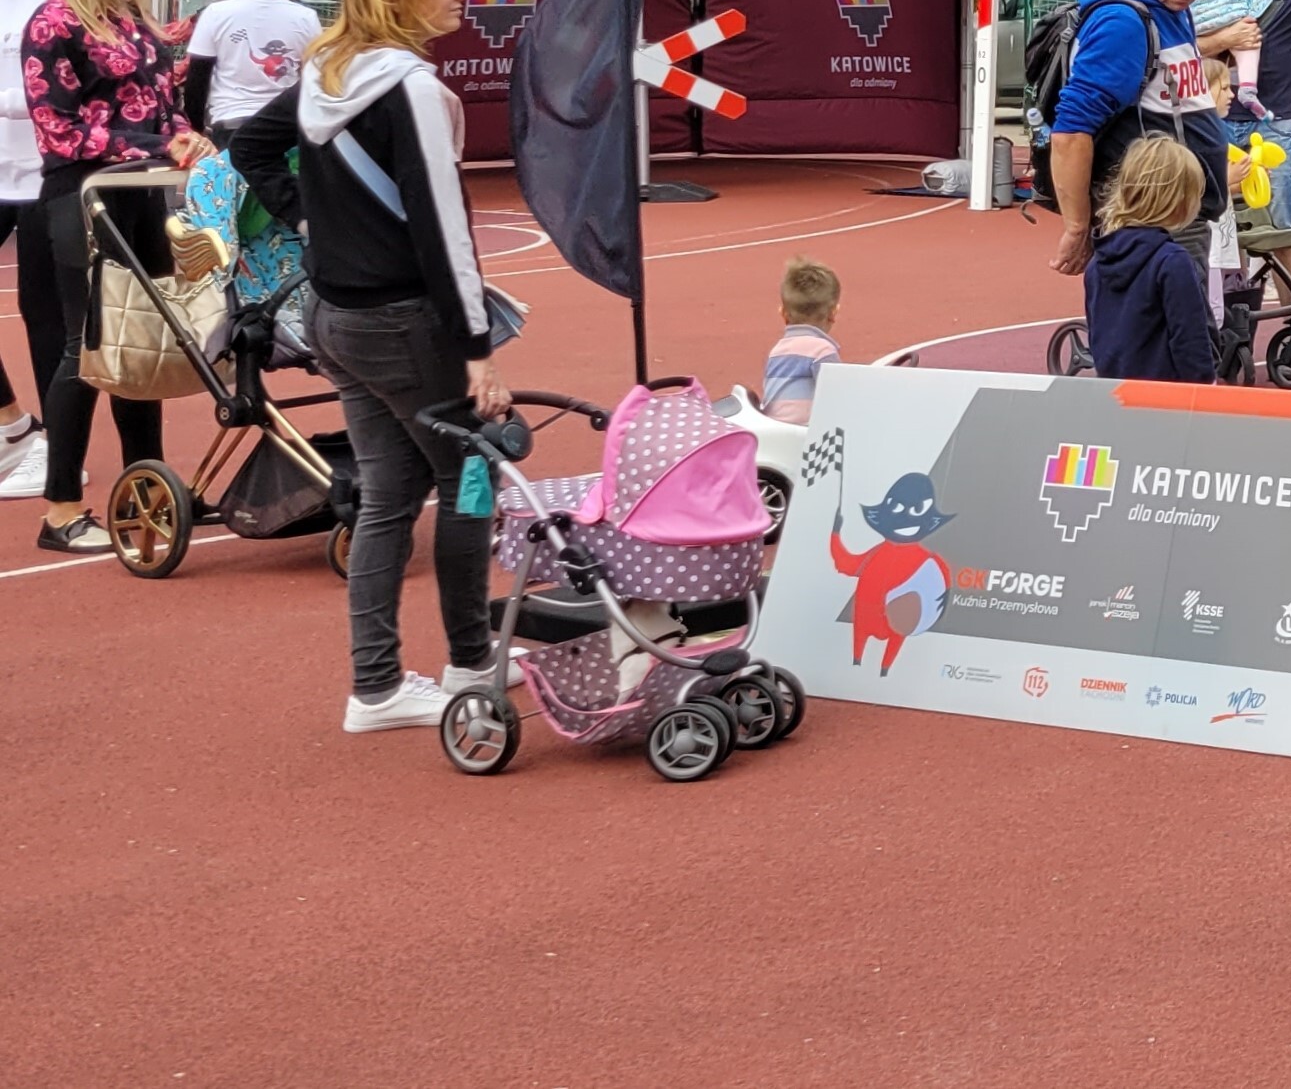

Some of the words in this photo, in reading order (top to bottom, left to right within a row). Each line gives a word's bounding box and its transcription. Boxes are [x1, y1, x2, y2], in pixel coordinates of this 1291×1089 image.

[443, 59, 514, 76] KATOW
[830, 56, 912, 73] KATOWICE
[865, 78, 897, 90] odmiany
[1128, 504, 1152, 522] dla
[1154, 507, 1221, 532] odmiany
[956, 567, 1065, 598] GKFORGE
[952, 594, 987, 608] Kuźnia
[989, 598, 1059, 615] Przemysłowa
[1196, 605, 1224, 618] KSSE
[1112, 609, 1139, 621] szeja
[1028, 674, 1044, 689] 112
[1080, 677, 1128, 693] DZIENNIK
[1164, 692, 1197, 706] POLICJA
